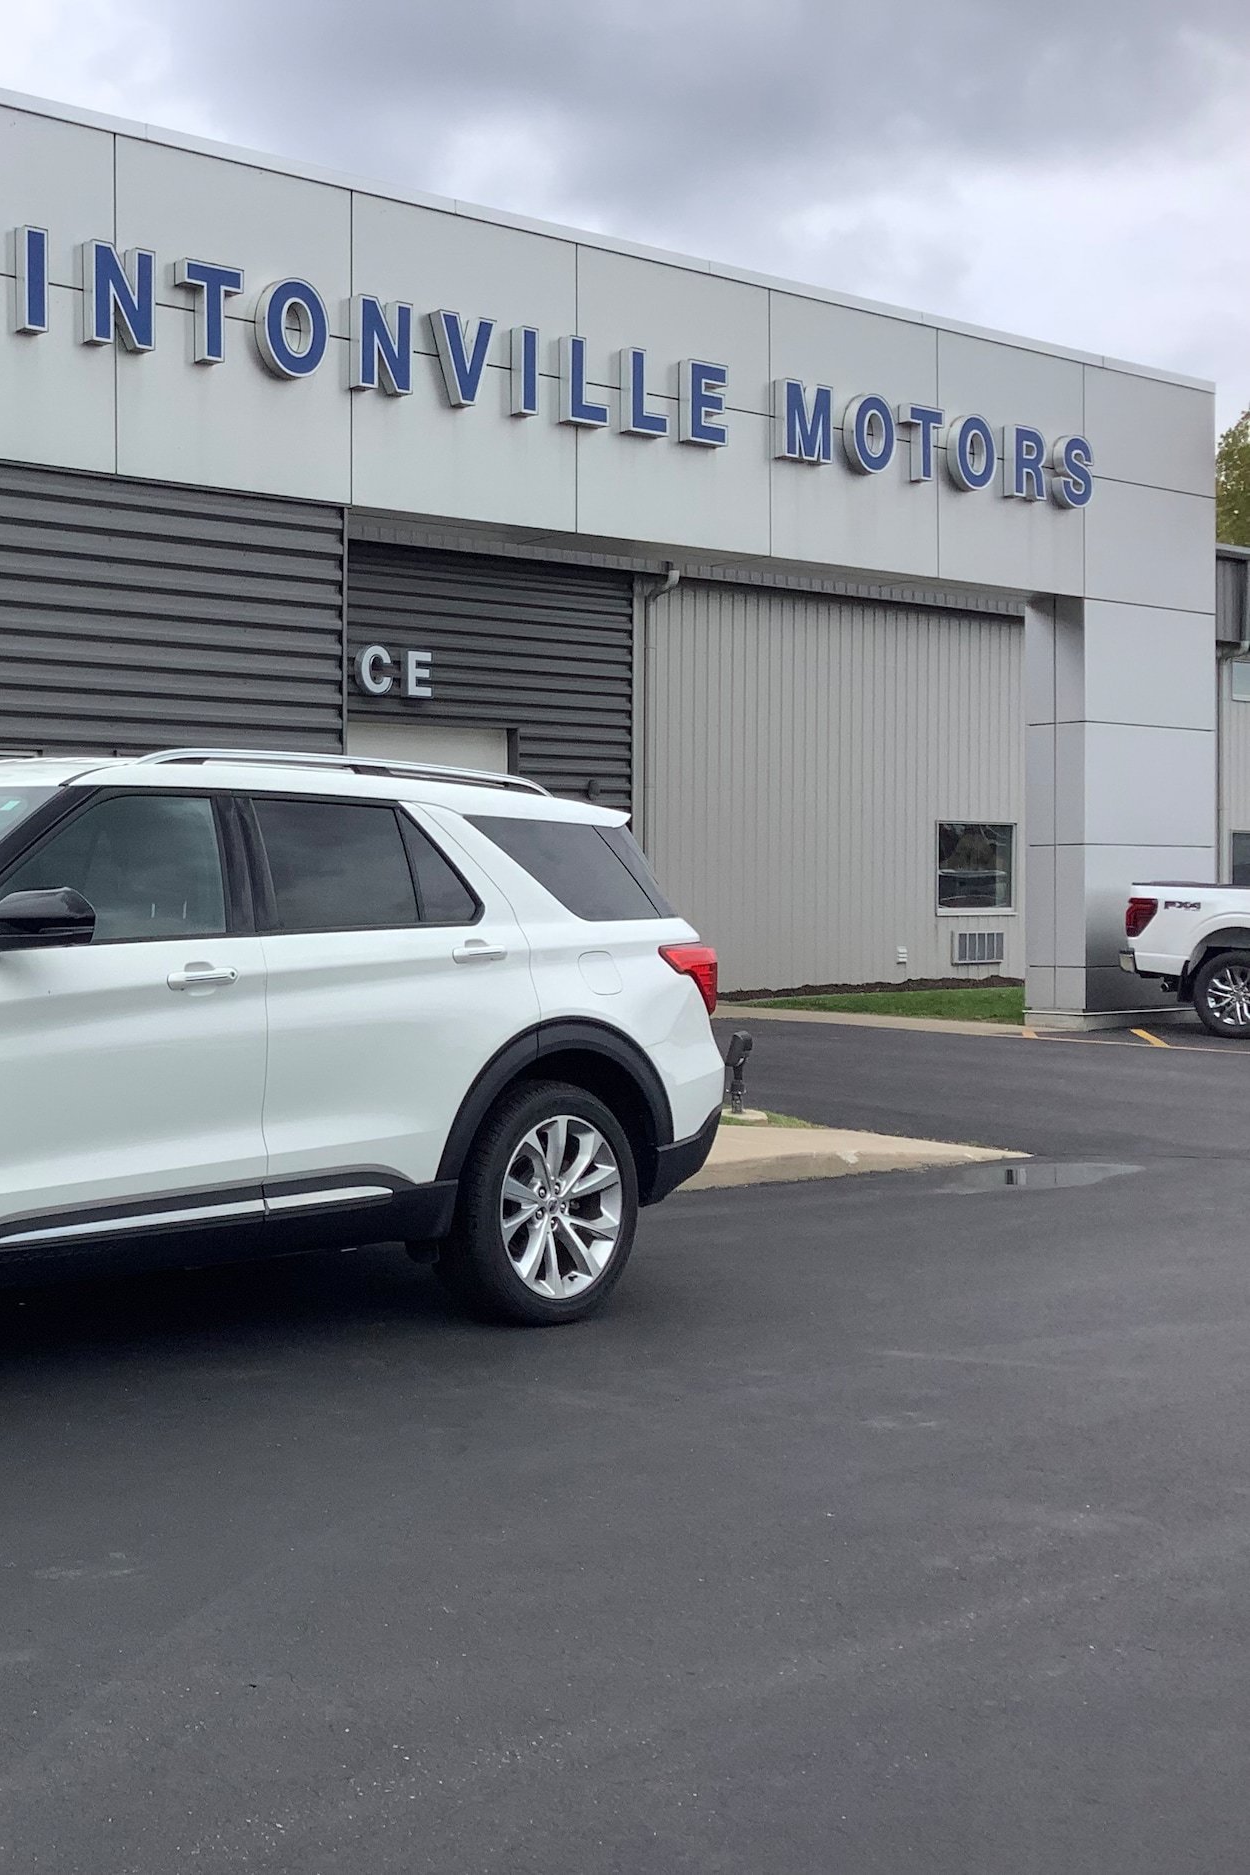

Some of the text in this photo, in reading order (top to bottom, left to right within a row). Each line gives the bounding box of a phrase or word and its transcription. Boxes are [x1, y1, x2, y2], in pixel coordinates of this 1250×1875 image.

[773, 377, 1094, 509] MOTORS
[355, 644, 435, 698] CE
[1163, 900, 1201, 911] FX4
